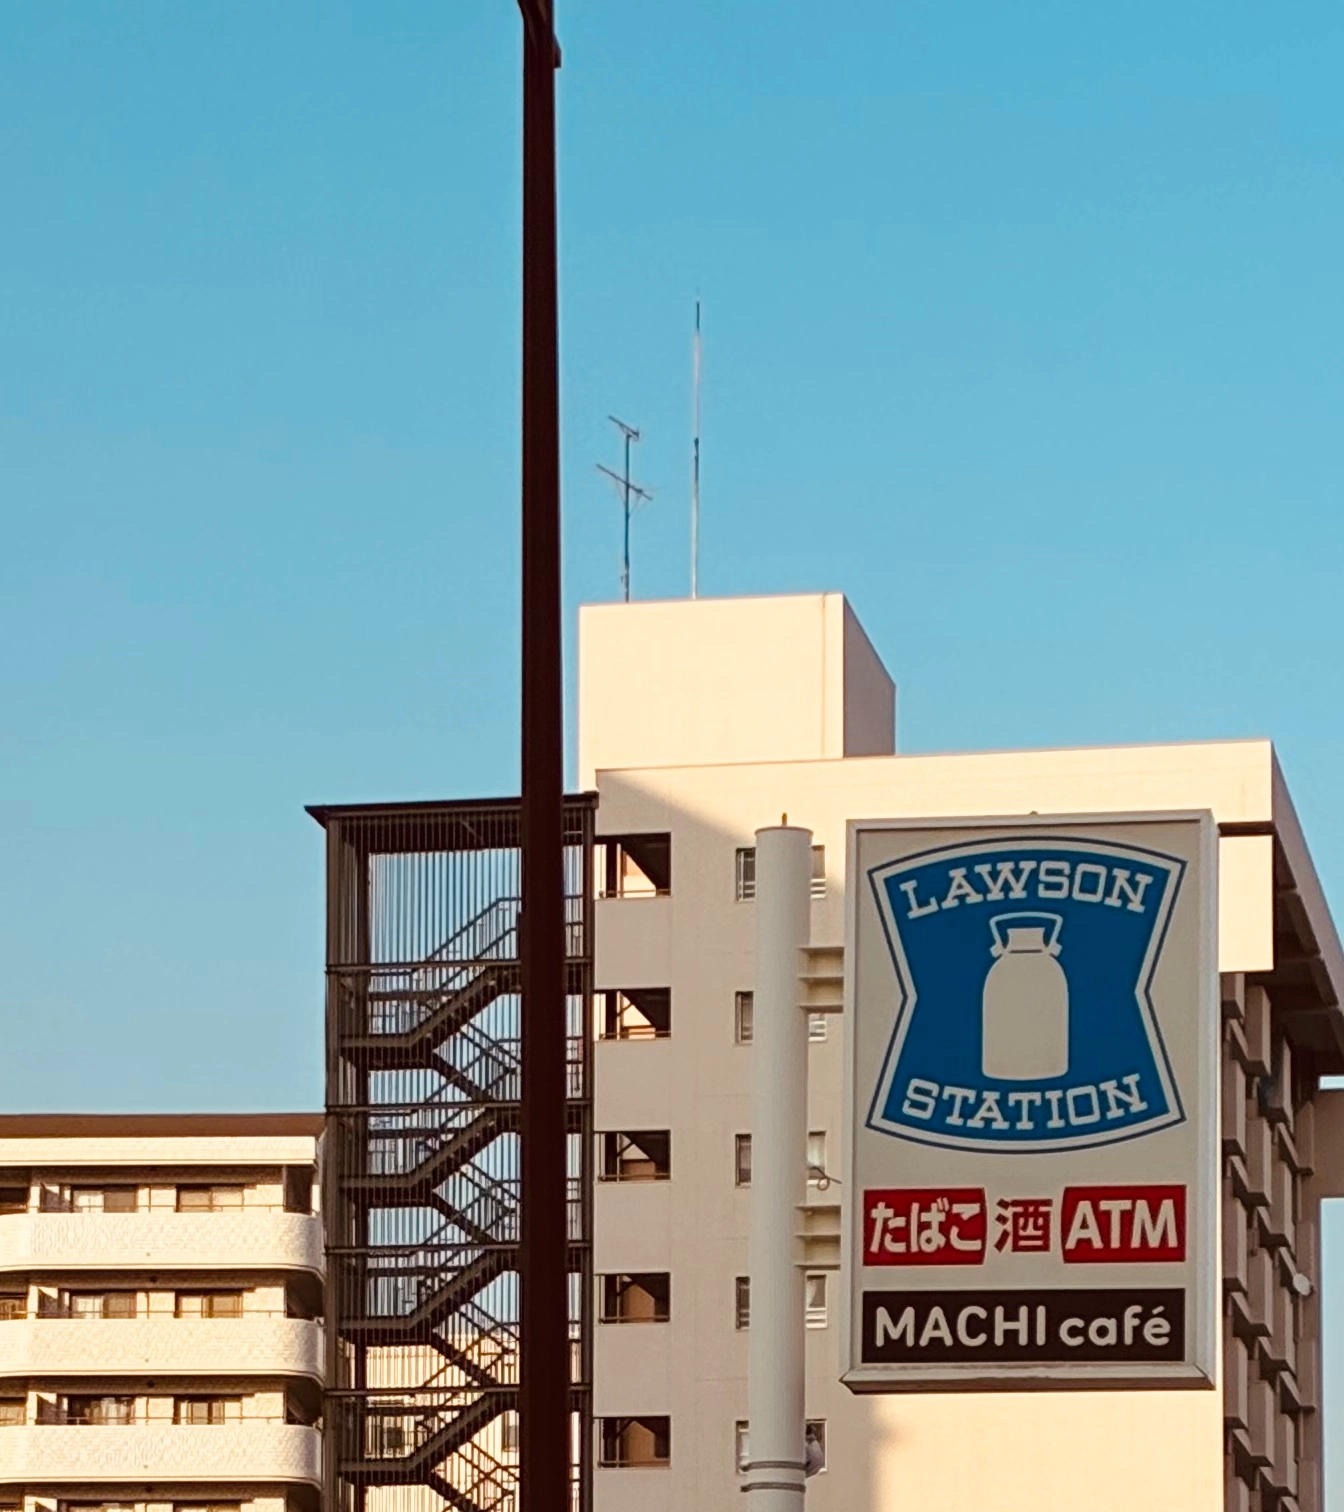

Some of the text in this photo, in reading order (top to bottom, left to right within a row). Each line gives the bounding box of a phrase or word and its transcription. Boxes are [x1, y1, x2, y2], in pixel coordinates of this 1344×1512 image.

[900, 860, 1153, 920] LAWSON
[903, 1074, 1148, 1131] STATION
[870, 1197, 1179, 1254] たばこ 酒 ATM
[874, 1305, 1171, 1348] MACHI café
